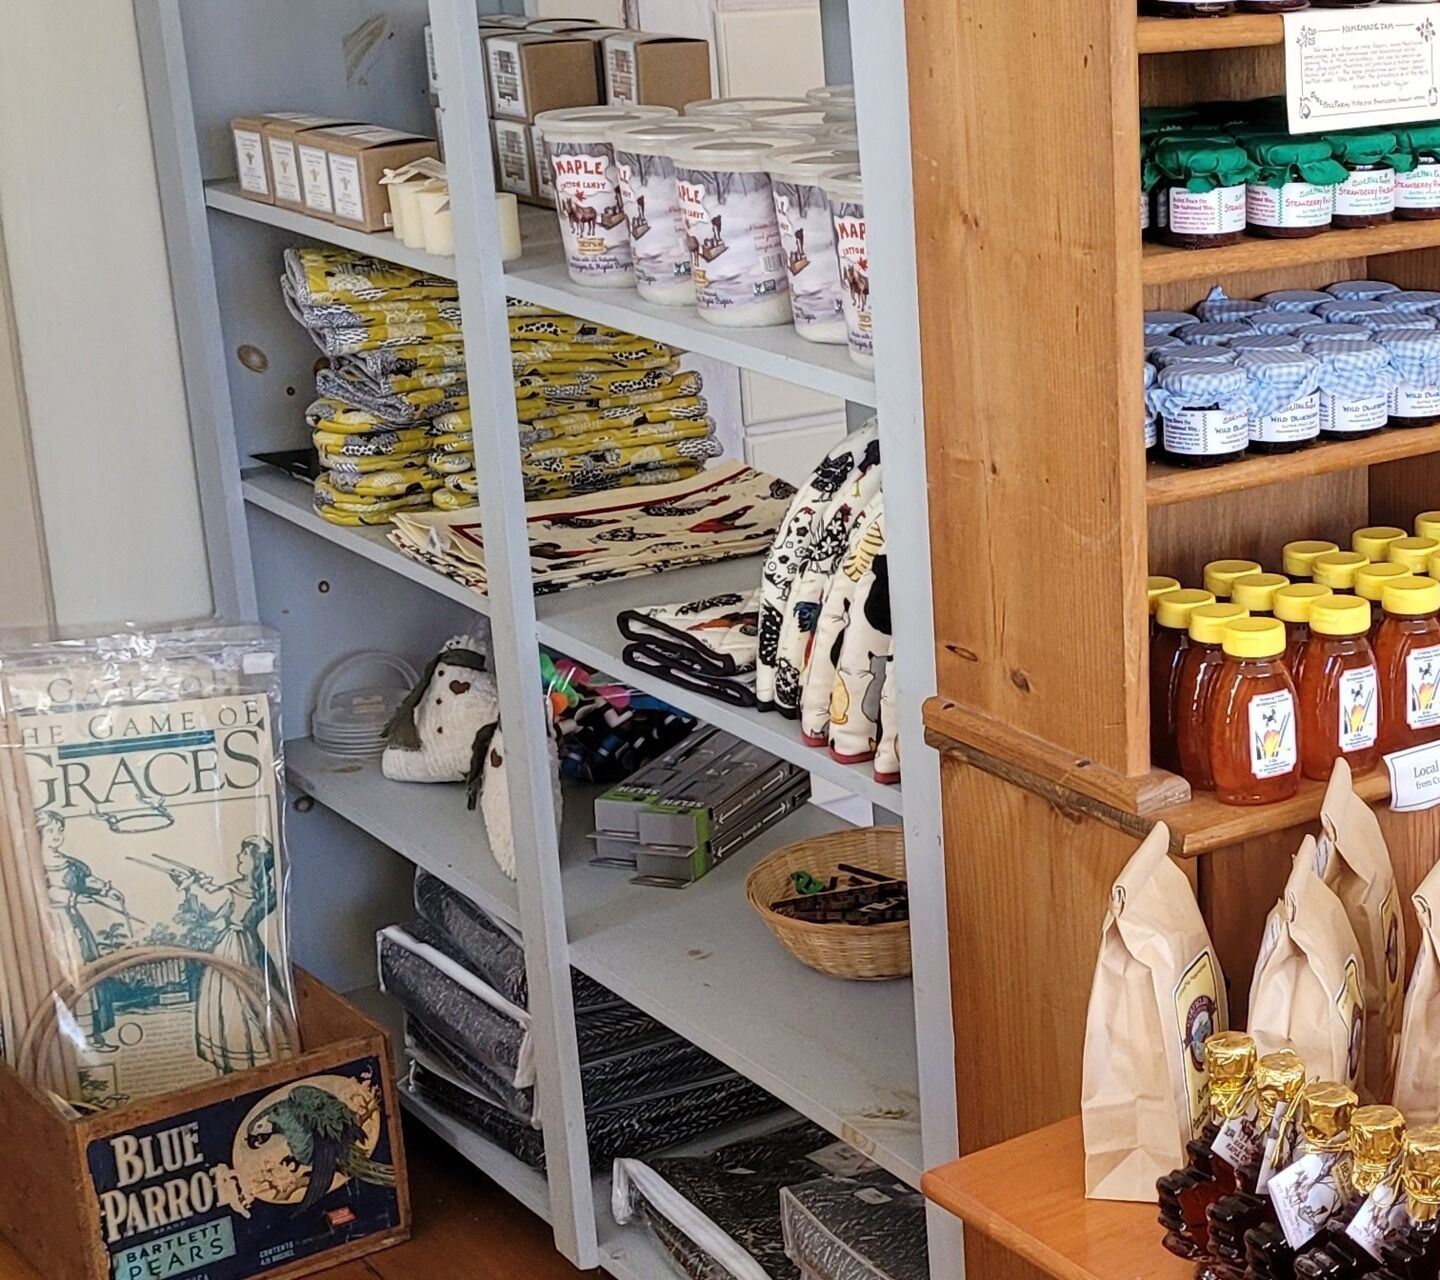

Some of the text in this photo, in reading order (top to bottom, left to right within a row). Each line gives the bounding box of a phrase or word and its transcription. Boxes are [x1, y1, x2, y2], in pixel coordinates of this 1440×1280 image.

[1342, 23, 1379, 33] HOMEMADE
[556, 159, 603, 175] MAPLE
[838, 222, 866, 240] MAP
[1270, 415, 1288, 423] WILD
[22, 699, 259, 745] HE GAME OF
[24, 729, 263, 812] GRACES
[1413, 760, 1440, 778] Local
[1415, 780, 1432, 790] from
[110, 1122, 203, 1188] BLUE
[101, 1163, 230, 1244] PARROT
[127, 1224, 221, 1263] BARTLETT
[259, 1241, 295, 1258] CONTENTS
